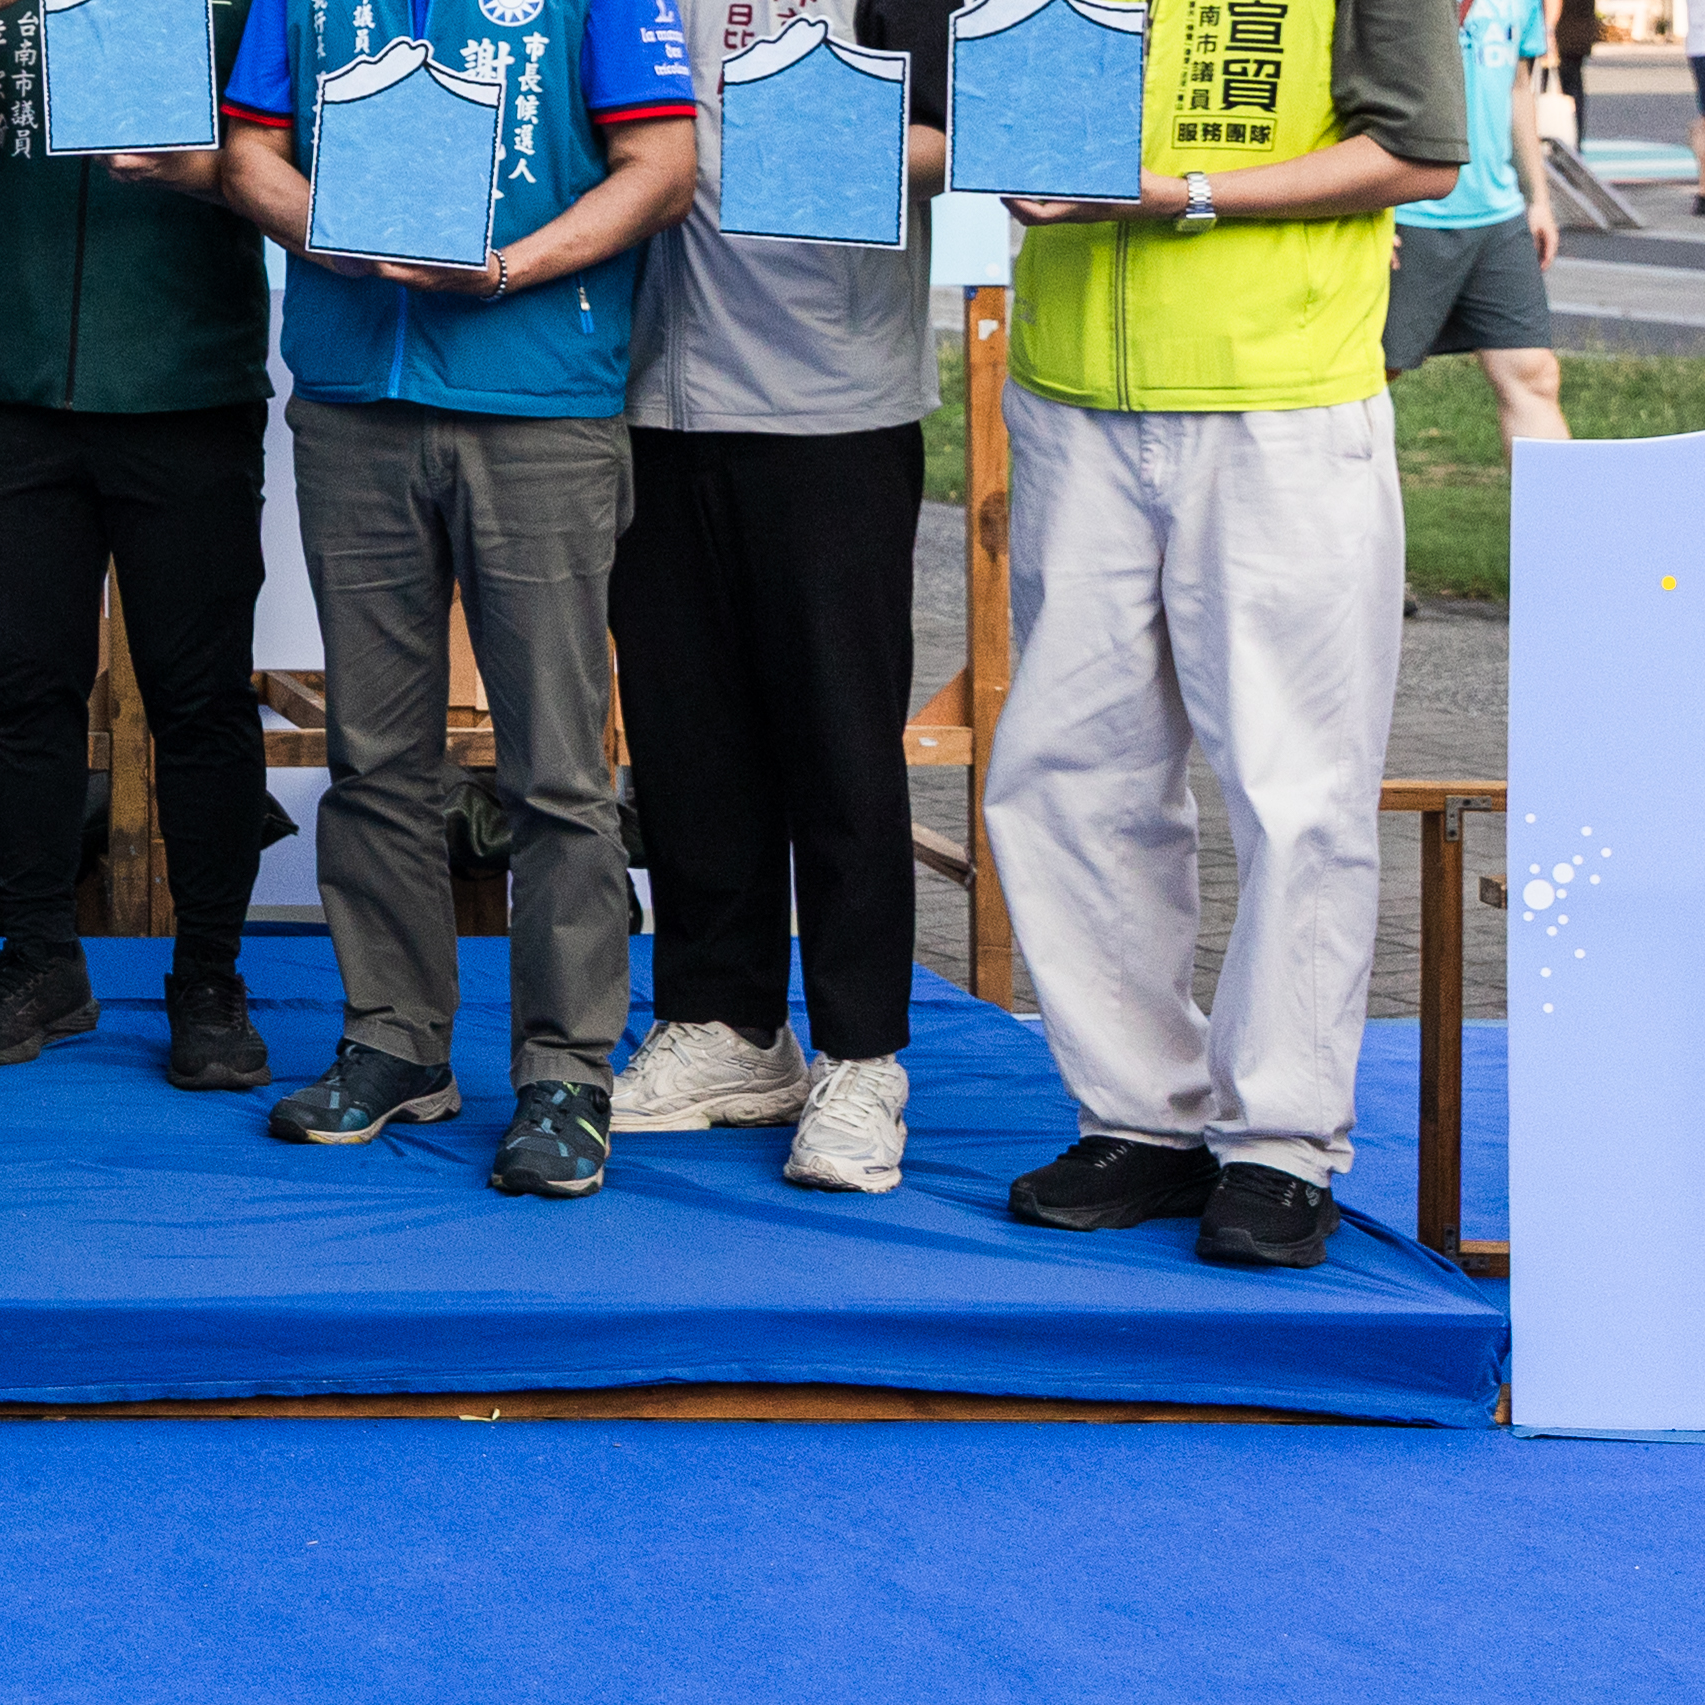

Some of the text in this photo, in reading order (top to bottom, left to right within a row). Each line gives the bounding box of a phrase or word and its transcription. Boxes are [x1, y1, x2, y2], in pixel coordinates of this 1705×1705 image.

[11, 11, 39, 159] 台南市議員
[508, 32, 550, 184] 市長候選人
[1177, 122, 1272, 145] 服務團隊
